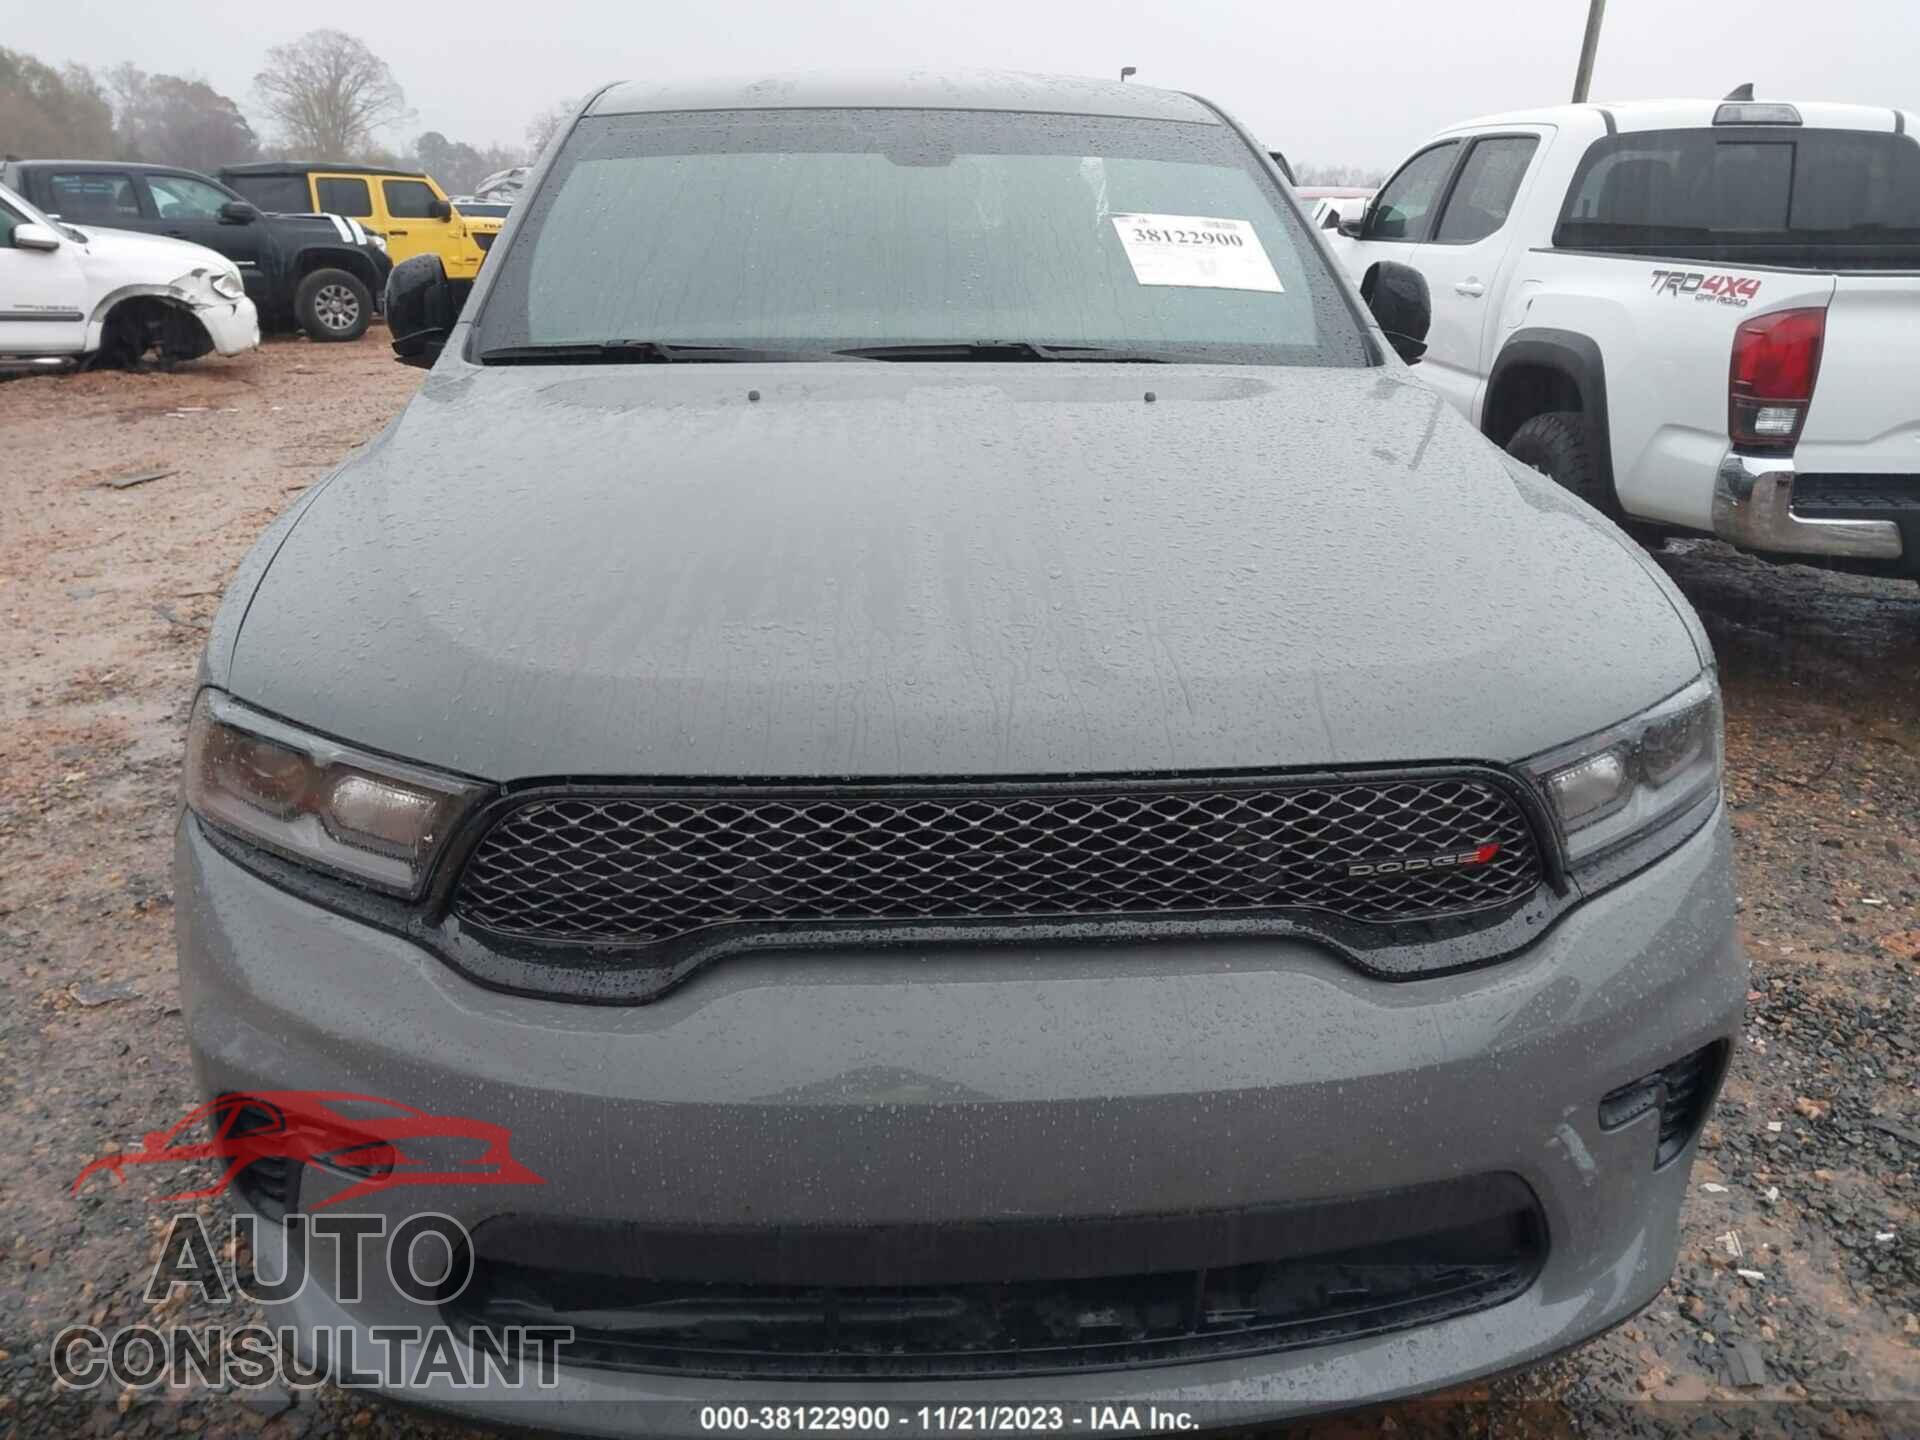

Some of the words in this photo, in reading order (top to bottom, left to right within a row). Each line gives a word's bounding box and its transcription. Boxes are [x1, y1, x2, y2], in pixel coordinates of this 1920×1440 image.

[1132, 228, 1243, 246] 38122900
[1716, 296, 1748, 307] ROAD
[1348, 850, 1481, 876] DODGE
